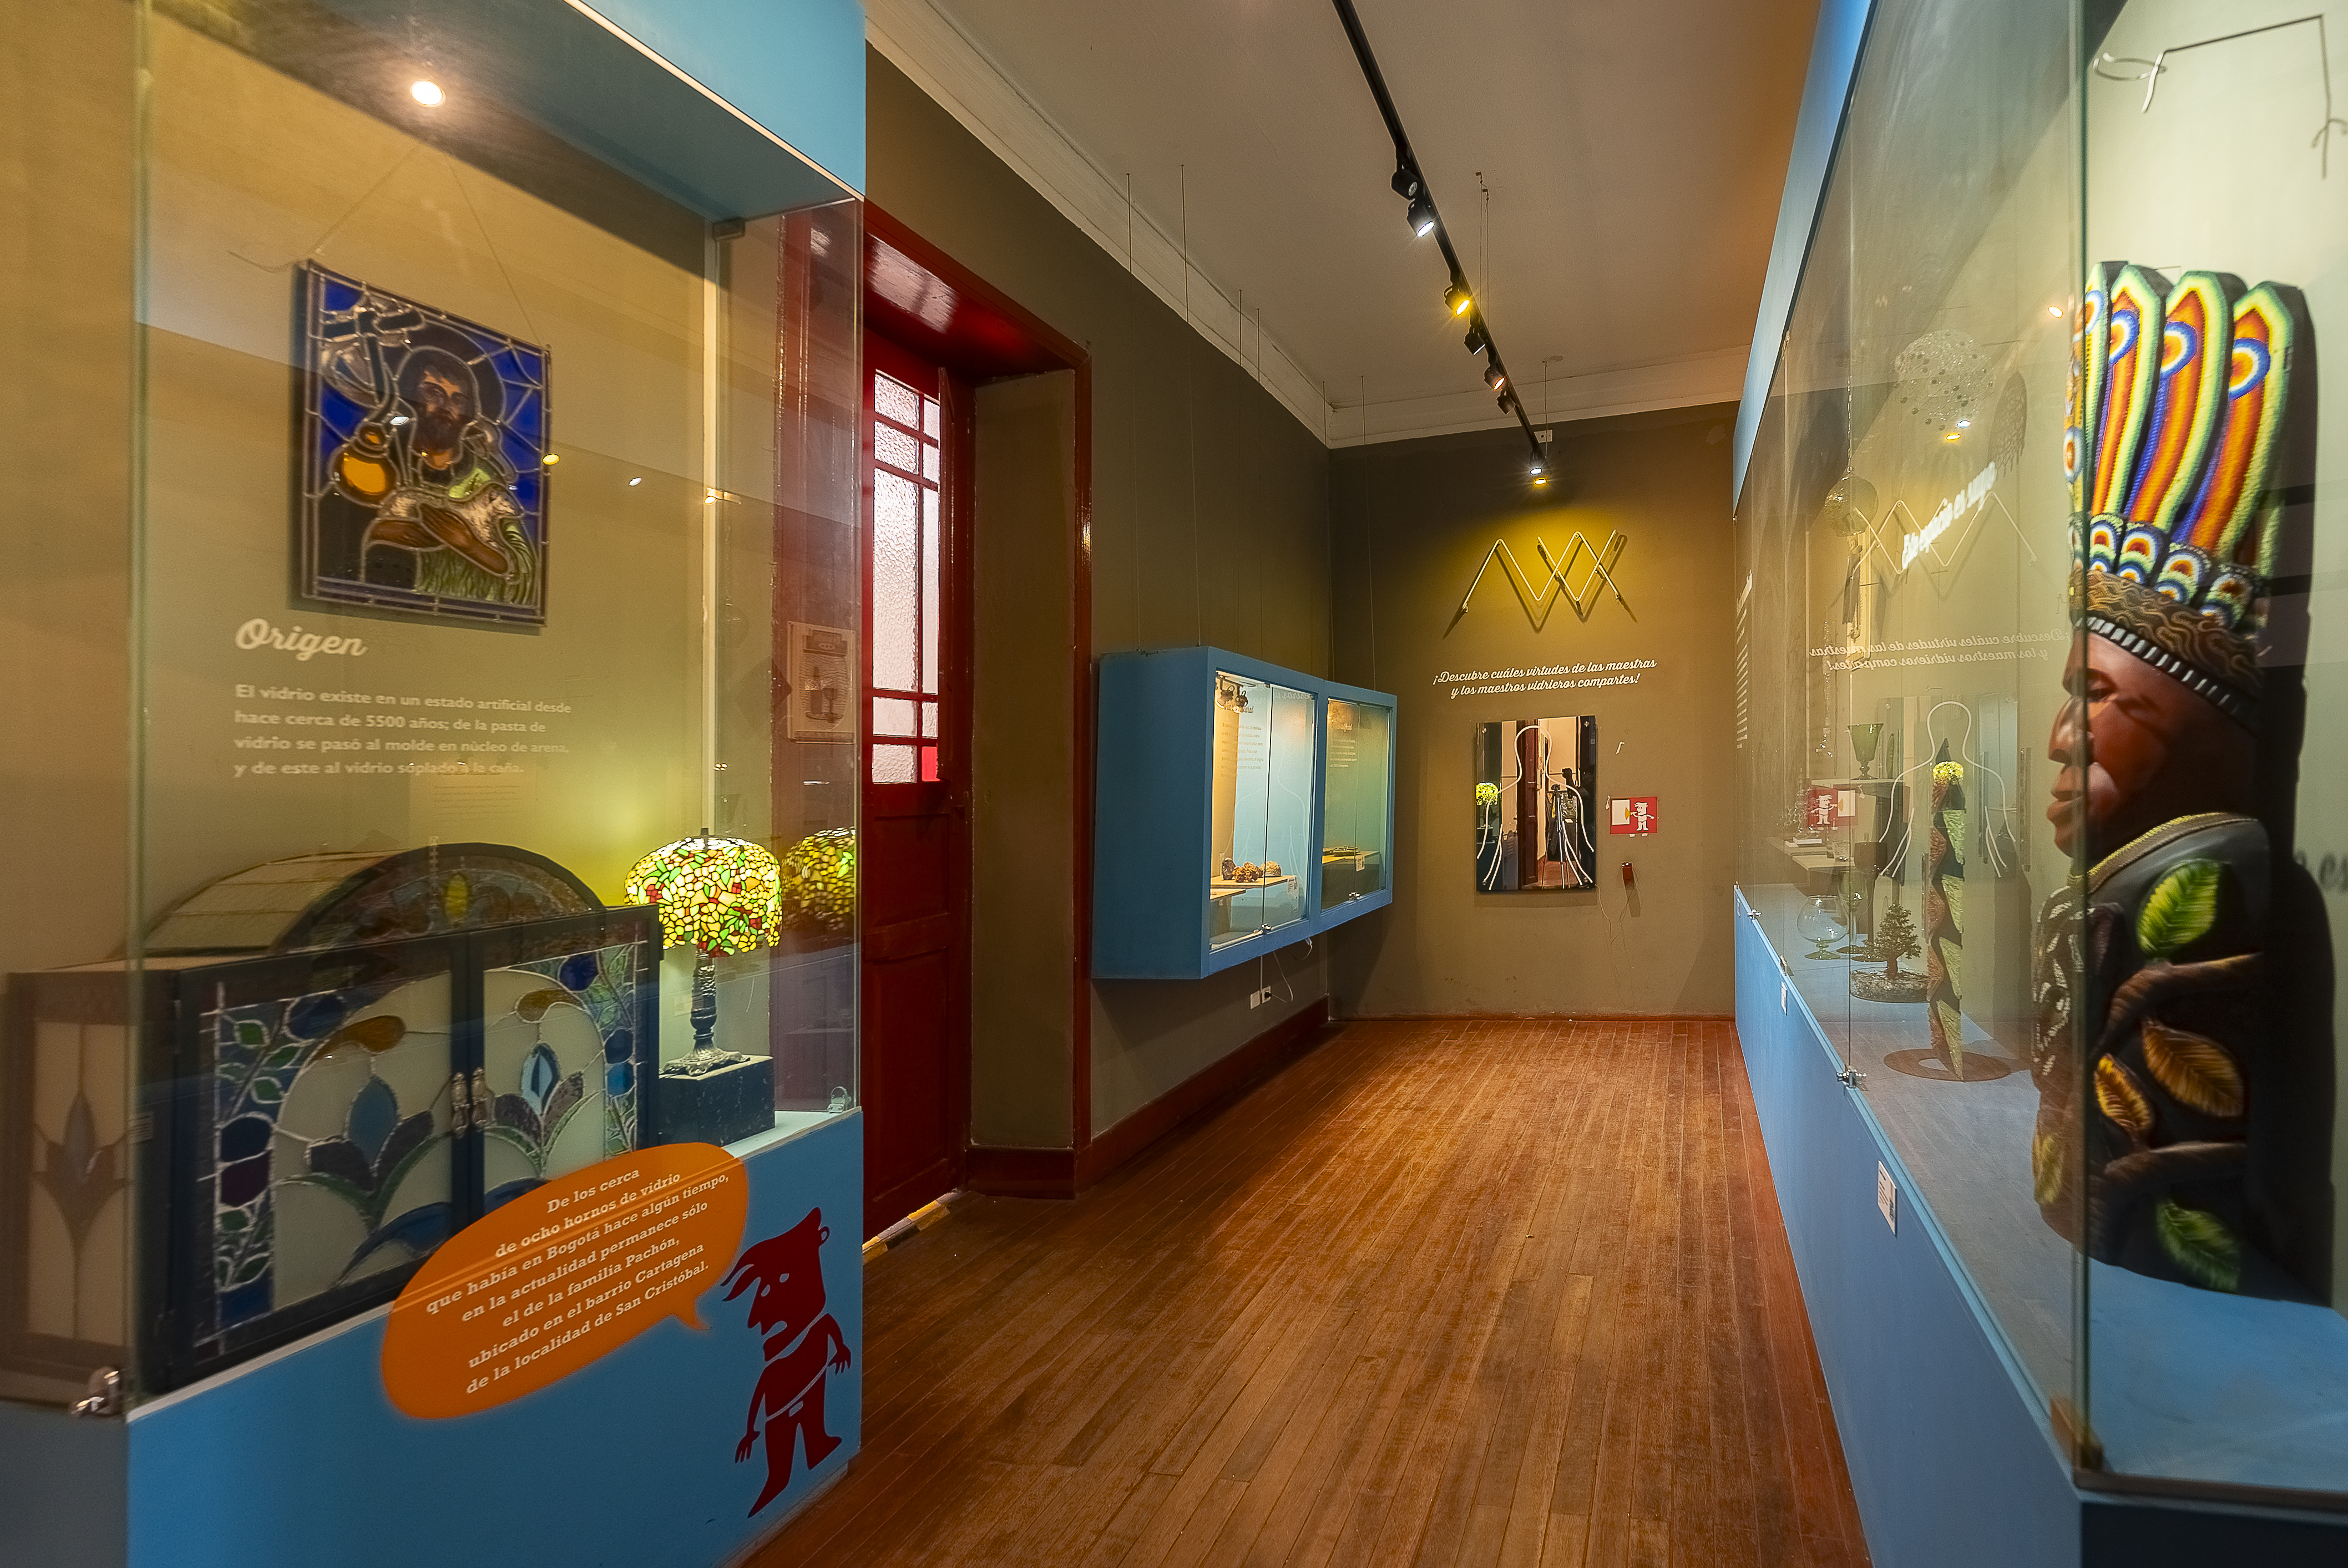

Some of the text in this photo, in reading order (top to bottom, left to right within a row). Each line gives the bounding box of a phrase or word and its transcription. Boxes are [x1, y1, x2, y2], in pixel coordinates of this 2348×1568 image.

[235, 618, 368, 661] Origen
[1433, 658, 1657, 685] ¡Descubre cuáles virtudes de las maestras
[1450, 673, 1641, 699] y los maestros vidrieros compartes!
[235, 684, 572, 713] El vidrio existe en un estado artificial desde
[235, 710, 281, 724] hace
[285, 715, 335, 725] cerca
[338, 714, 362, 727] de
[366, 715, 406, 728] 5500
[452, 718, 471, 729] de
[474, 719, 488, 730] la
[490, 722, 527, 733] pasta
[529, 721, 547, 732] de
[234, 736, 292, 749] vidrio
[295, 740, 316, 750] se
[321, 738, 361, 753] pasó
[366, 738, 381, 750] al
[385, 739, 435, 751] molde
[438, 742, 457, 751] en
[461, 741, 507, 752] núcleo
[510, 741, 527, 752] de
[234, 765, 247, 778] y
[251, 761, 276, 774] de
[281, 764, 320, 774] este
[324, 762, 340, 773] al
[345, 762, 393, 774] vidrio
[473, 762, 486, 773] la
[547, 1169, 640, 1213] De los cerca
[495, 1173, 680, 1257] de ocho hornos de vidrio
[427, 1174, 729, 1315] que había en Bogotá hace algún tiempo,
[462, 1201, 708, 1321] en la actualidad permanece sólo
[503, 1236, 680, 1327] el de la familia Pachón,
[467, 1261, 709, 1394] de la localidad de San Cristóbal.
[468, 1244, 705, 1368] ubicado en el barrio Cartagena
